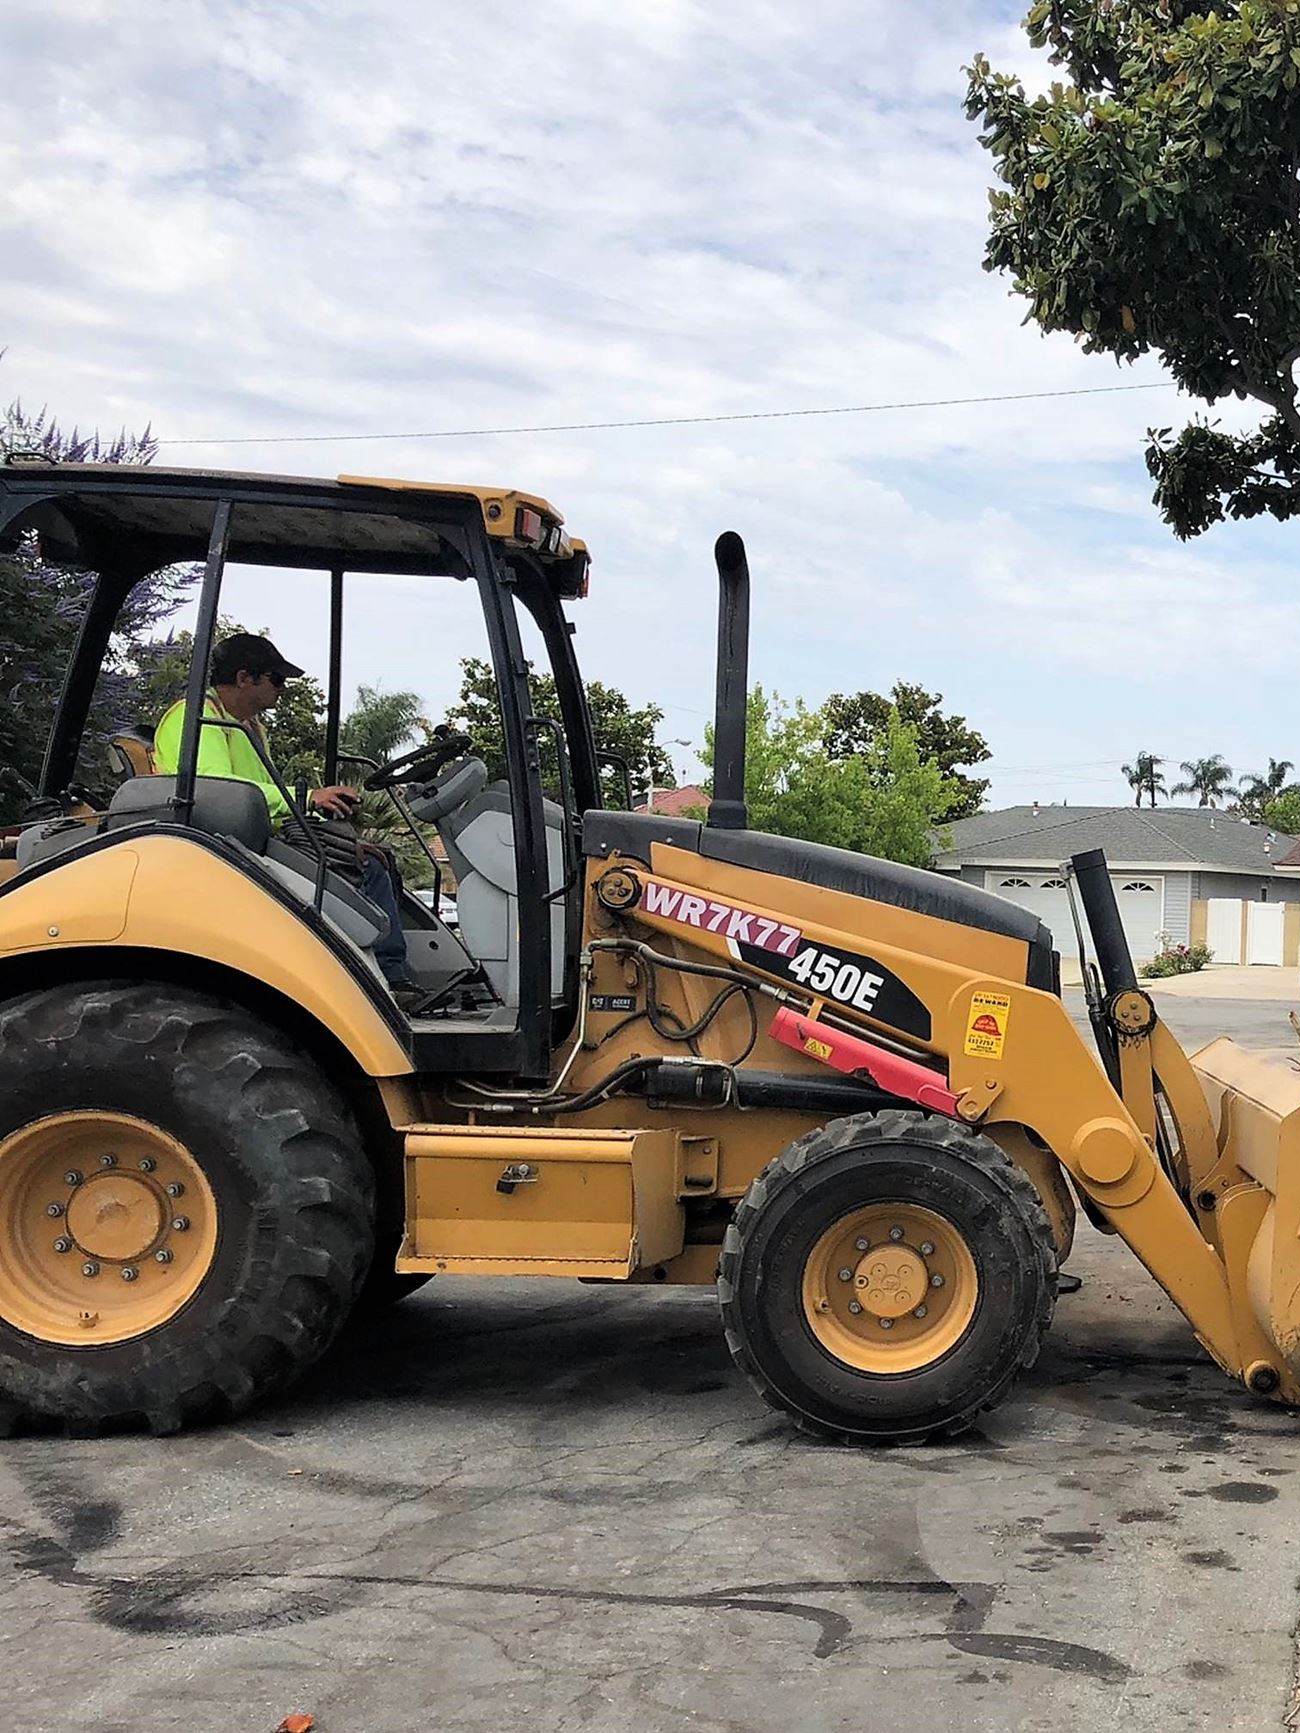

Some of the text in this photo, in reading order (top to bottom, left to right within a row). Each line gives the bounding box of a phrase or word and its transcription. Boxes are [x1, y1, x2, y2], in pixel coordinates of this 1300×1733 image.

[646, 884, 801, 956] WR7K77
[788, 947, 884, 1012] 450E
[973, 997, 1009, 1007] REWARD
